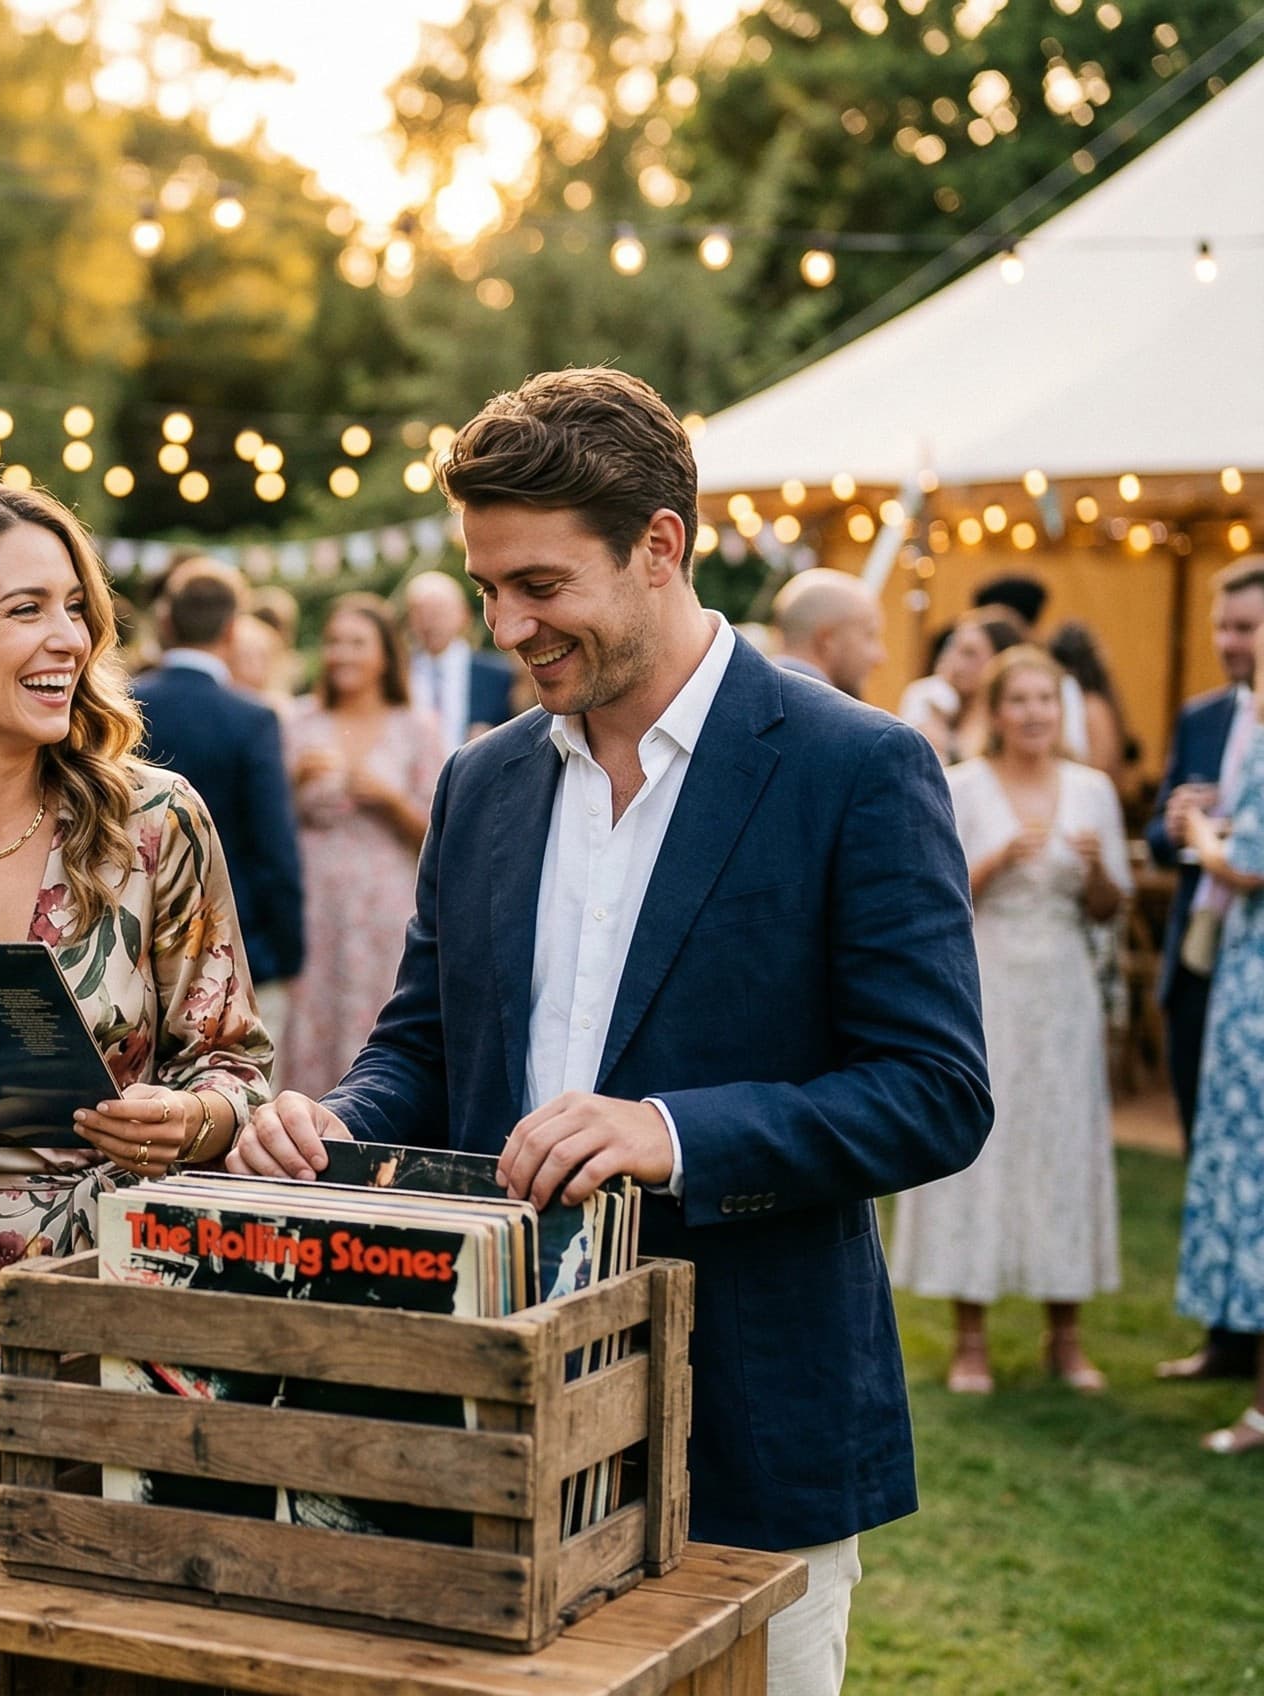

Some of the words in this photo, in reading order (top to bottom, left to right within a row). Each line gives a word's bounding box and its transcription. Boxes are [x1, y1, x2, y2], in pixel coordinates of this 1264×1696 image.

[125, 1211, 191, 1254] The
[197, 1218, 323, 1277] Rolling
[330, 1230, 453, 1282] Stones
